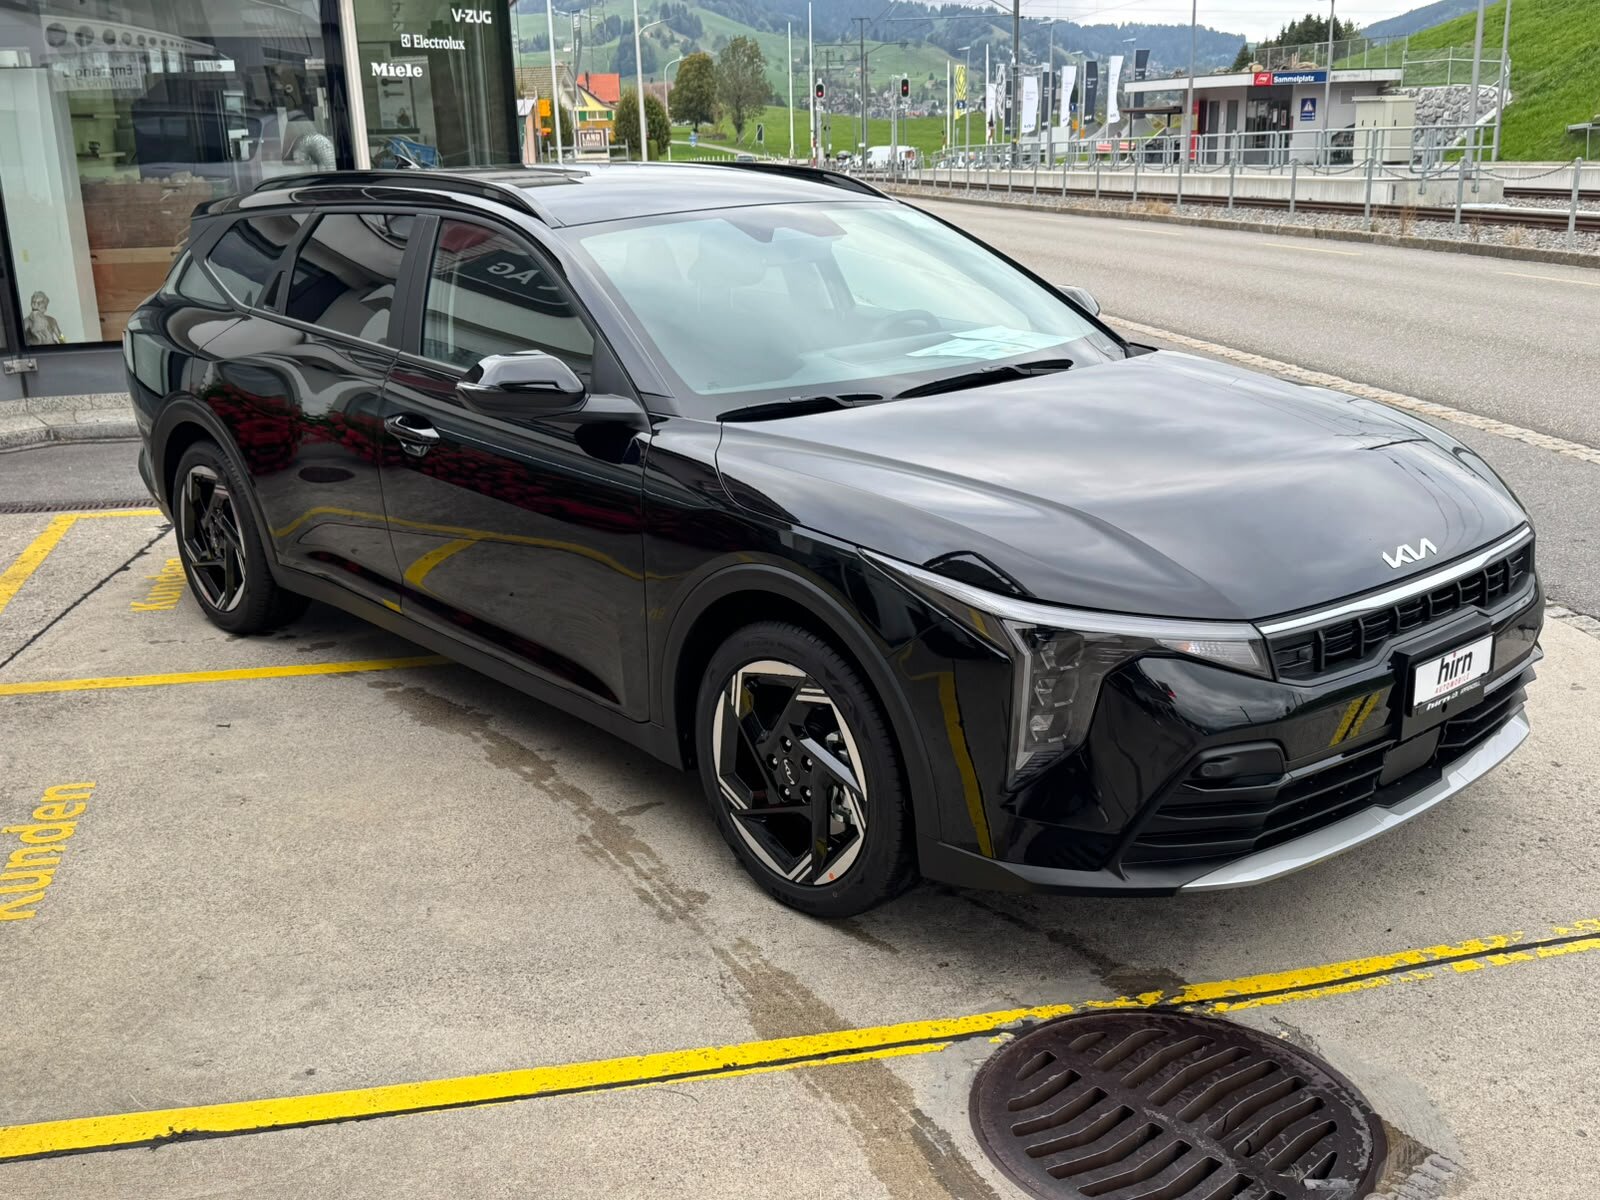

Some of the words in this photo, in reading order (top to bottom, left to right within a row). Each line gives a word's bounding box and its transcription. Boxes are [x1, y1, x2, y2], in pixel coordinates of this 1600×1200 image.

[451, 8, 492, 24] V-ZUG
[413, 35, 465, 50] Electrolux
[371, 62, 424, 78] Miele
[1273, 75, 1315, 85] Sammelplatz
[1382, 537, 1437, 569] KIA
[1437, 650, 1473, 685] hirn
